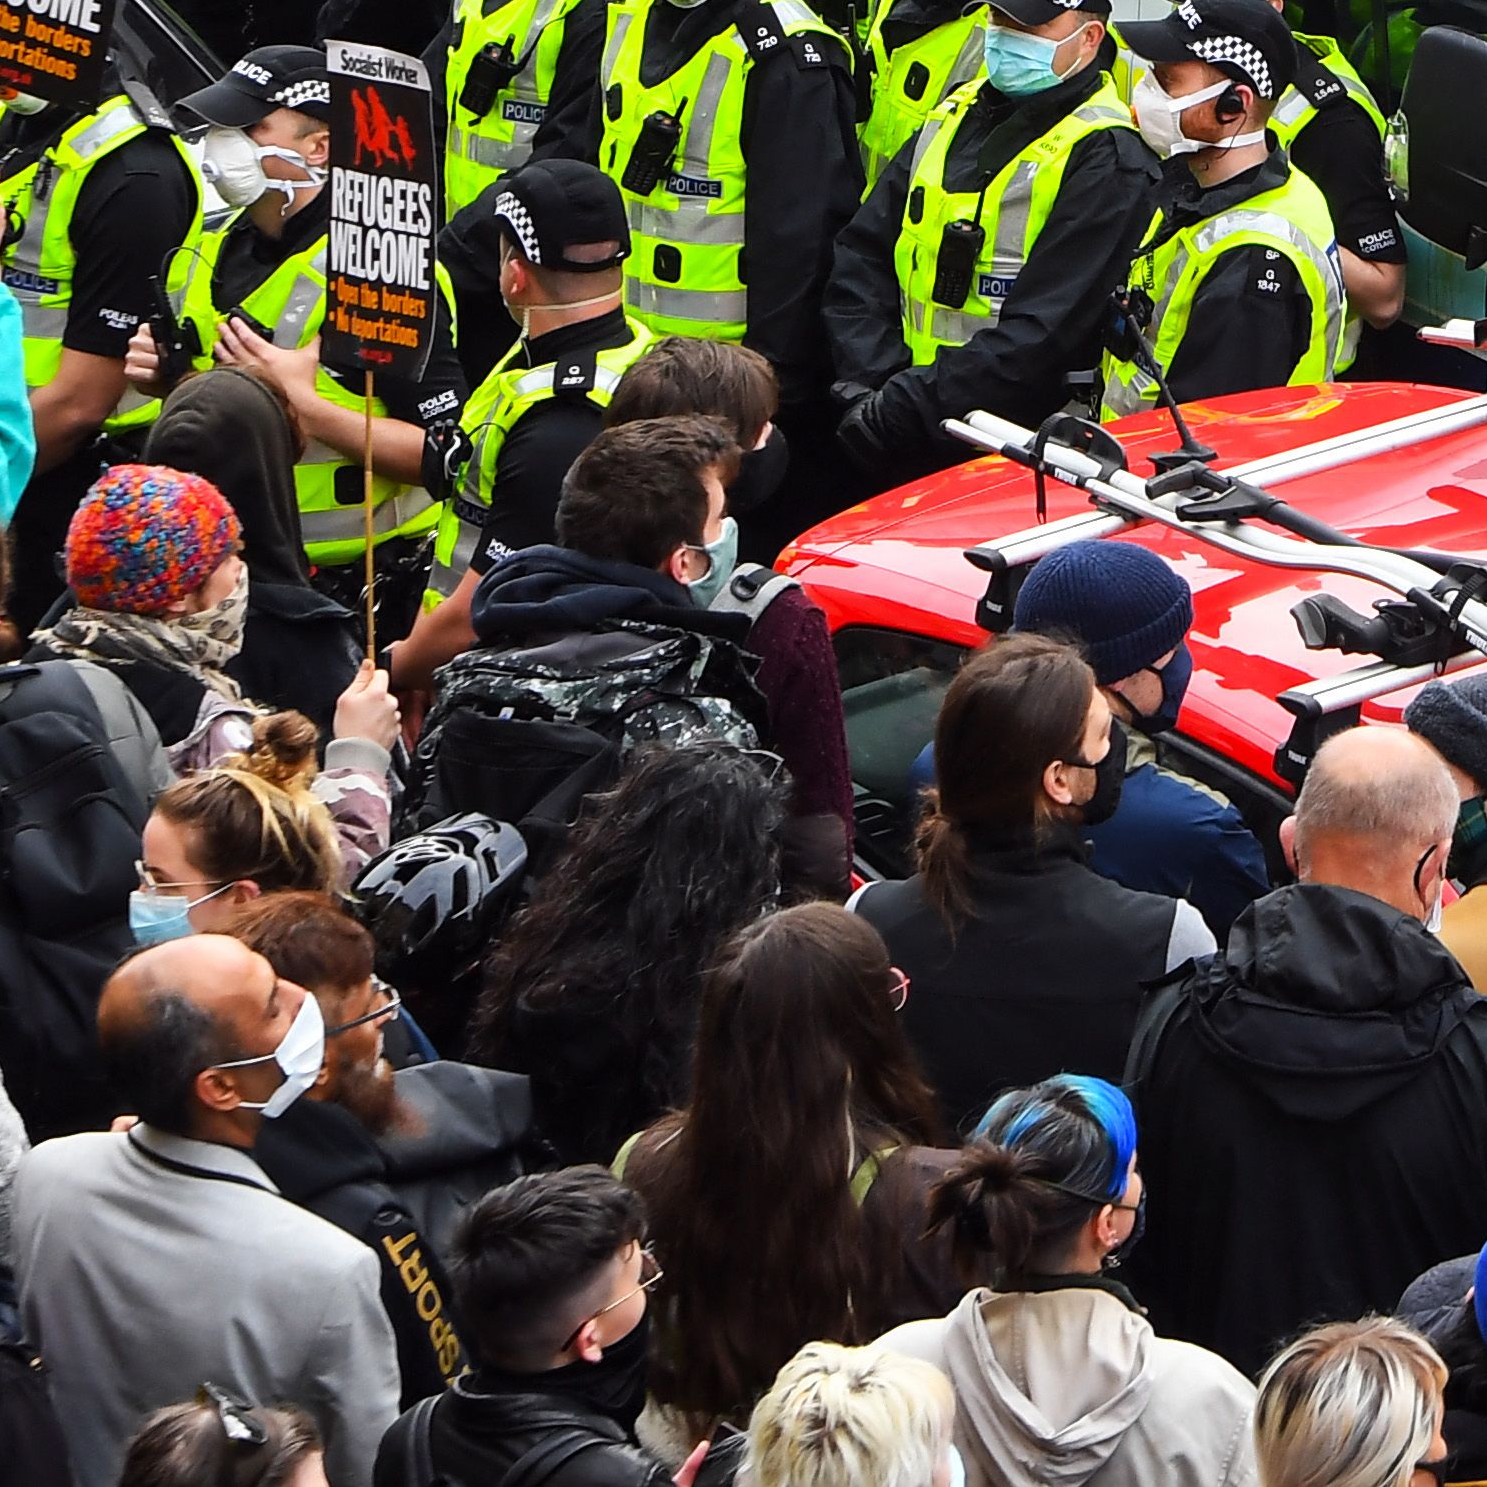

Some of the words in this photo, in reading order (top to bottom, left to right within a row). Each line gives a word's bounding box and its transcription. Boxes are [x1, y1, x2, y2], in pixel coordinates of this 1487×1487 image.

[25, 9, 92, 58] borders
[756, 35, 779, 52] 720
[340, 49, 383, 80] Socialist
[383, 55, 418, 85] Worker
[668, 172, 720, 196] POLICE
[330, 166, 432, 237] REFUGEES
[1358, 228, 1394, 248] POLICE
[329, 219, 431, 291] WELCOME
[981, 279, 1010, 296] POL
[1257, 280, 1281, 294] 1847
[1265, 269, 1276, 281] G
[337, 276, 360, 307] Open
[360, 281, 379, 310] the
[381, 286, 426, 319] borders
[416, 389, 457, 414] POLICE
[381, 1231, 461, 1375] SPORT
